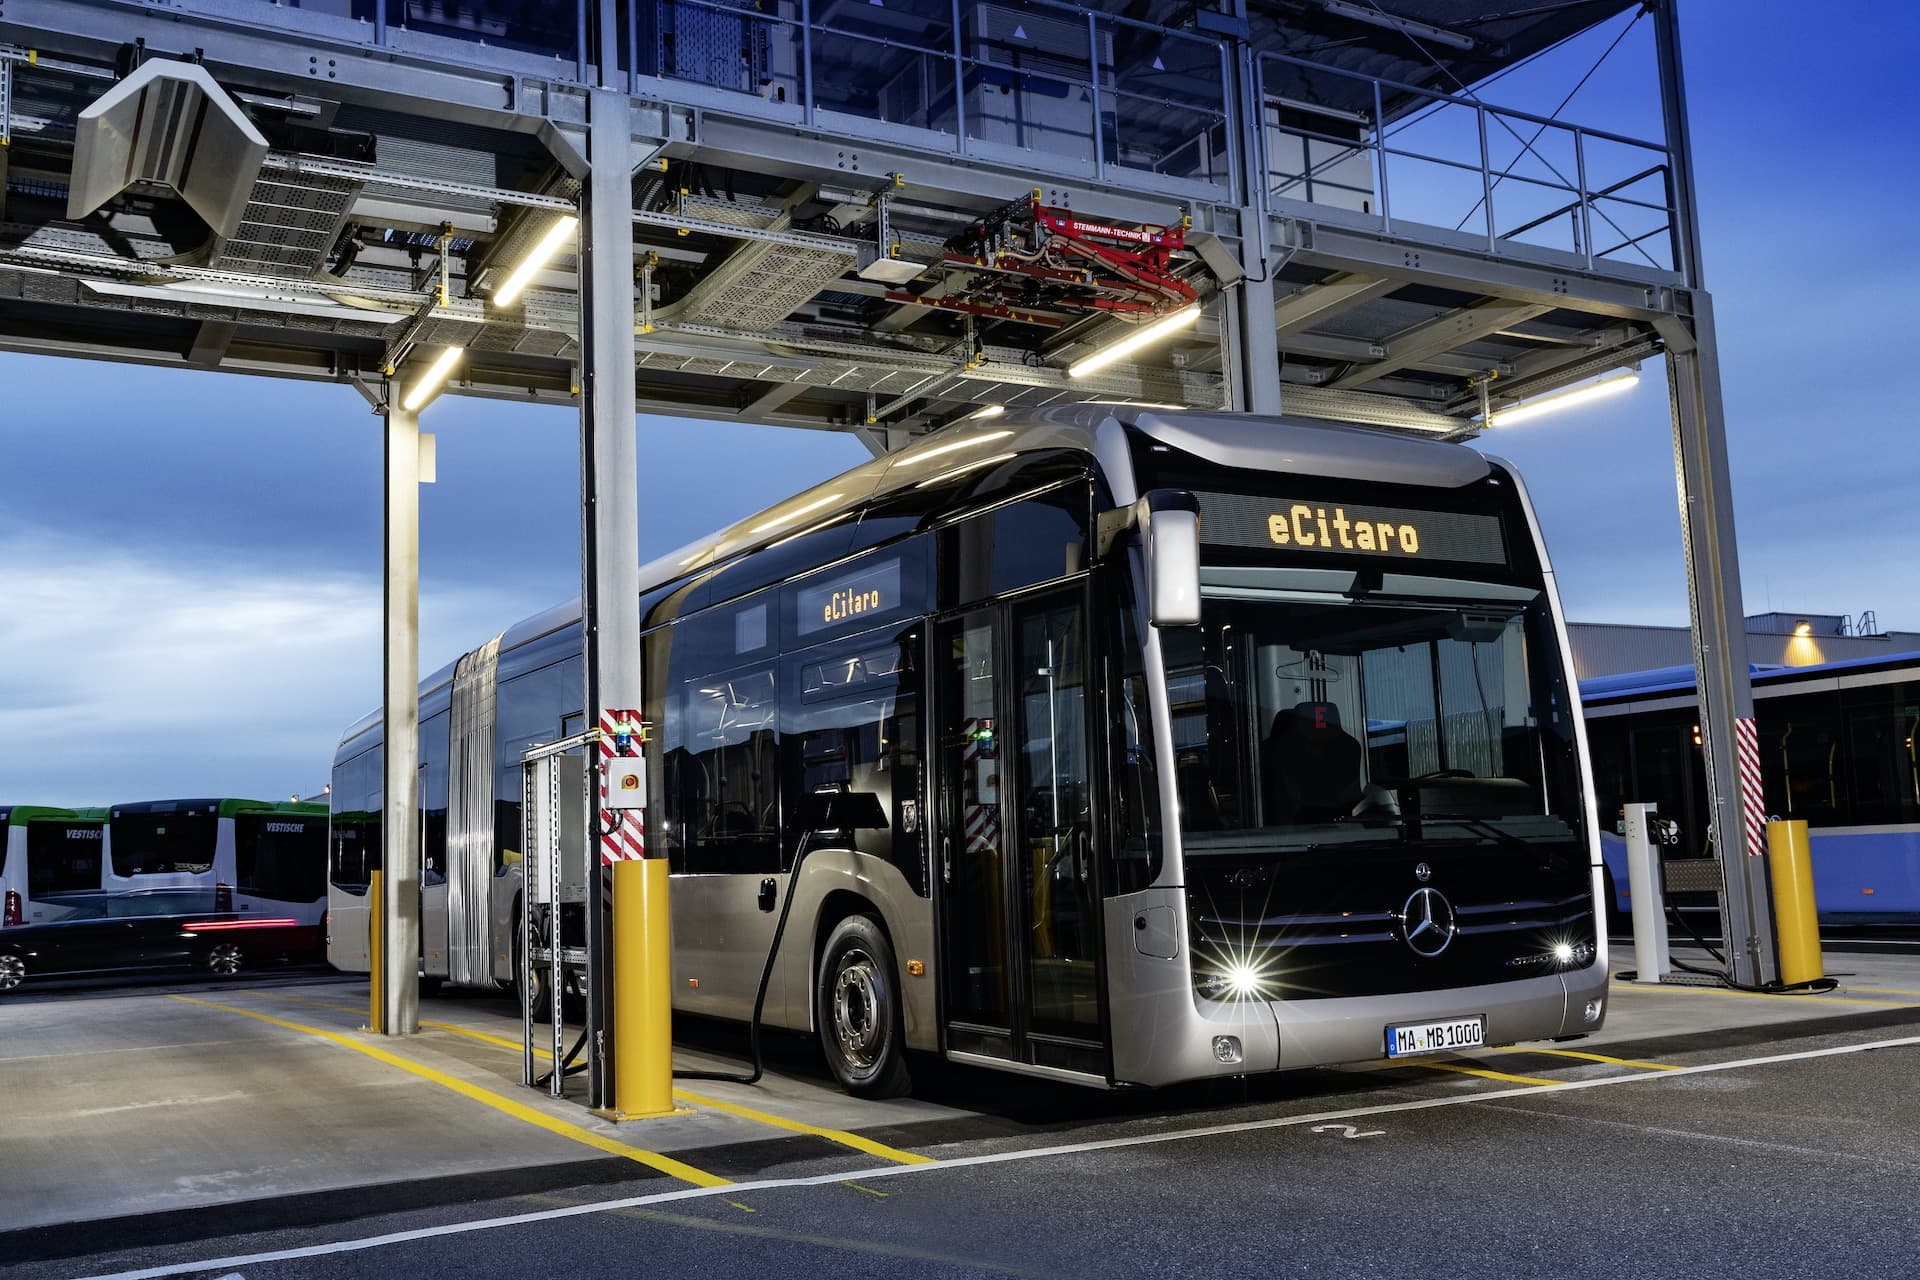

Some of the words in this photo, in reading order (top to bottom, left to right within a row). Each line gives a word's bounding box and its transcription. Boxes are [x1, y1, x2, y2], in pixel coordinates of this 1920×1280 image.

[1267, 504, 1419, 554] eCitaro
[824, 587, 879, 622] eCitaro
[266, 822, 305, 833] VESTISCHE
[1398, 1030, 1416, 1051] MA
